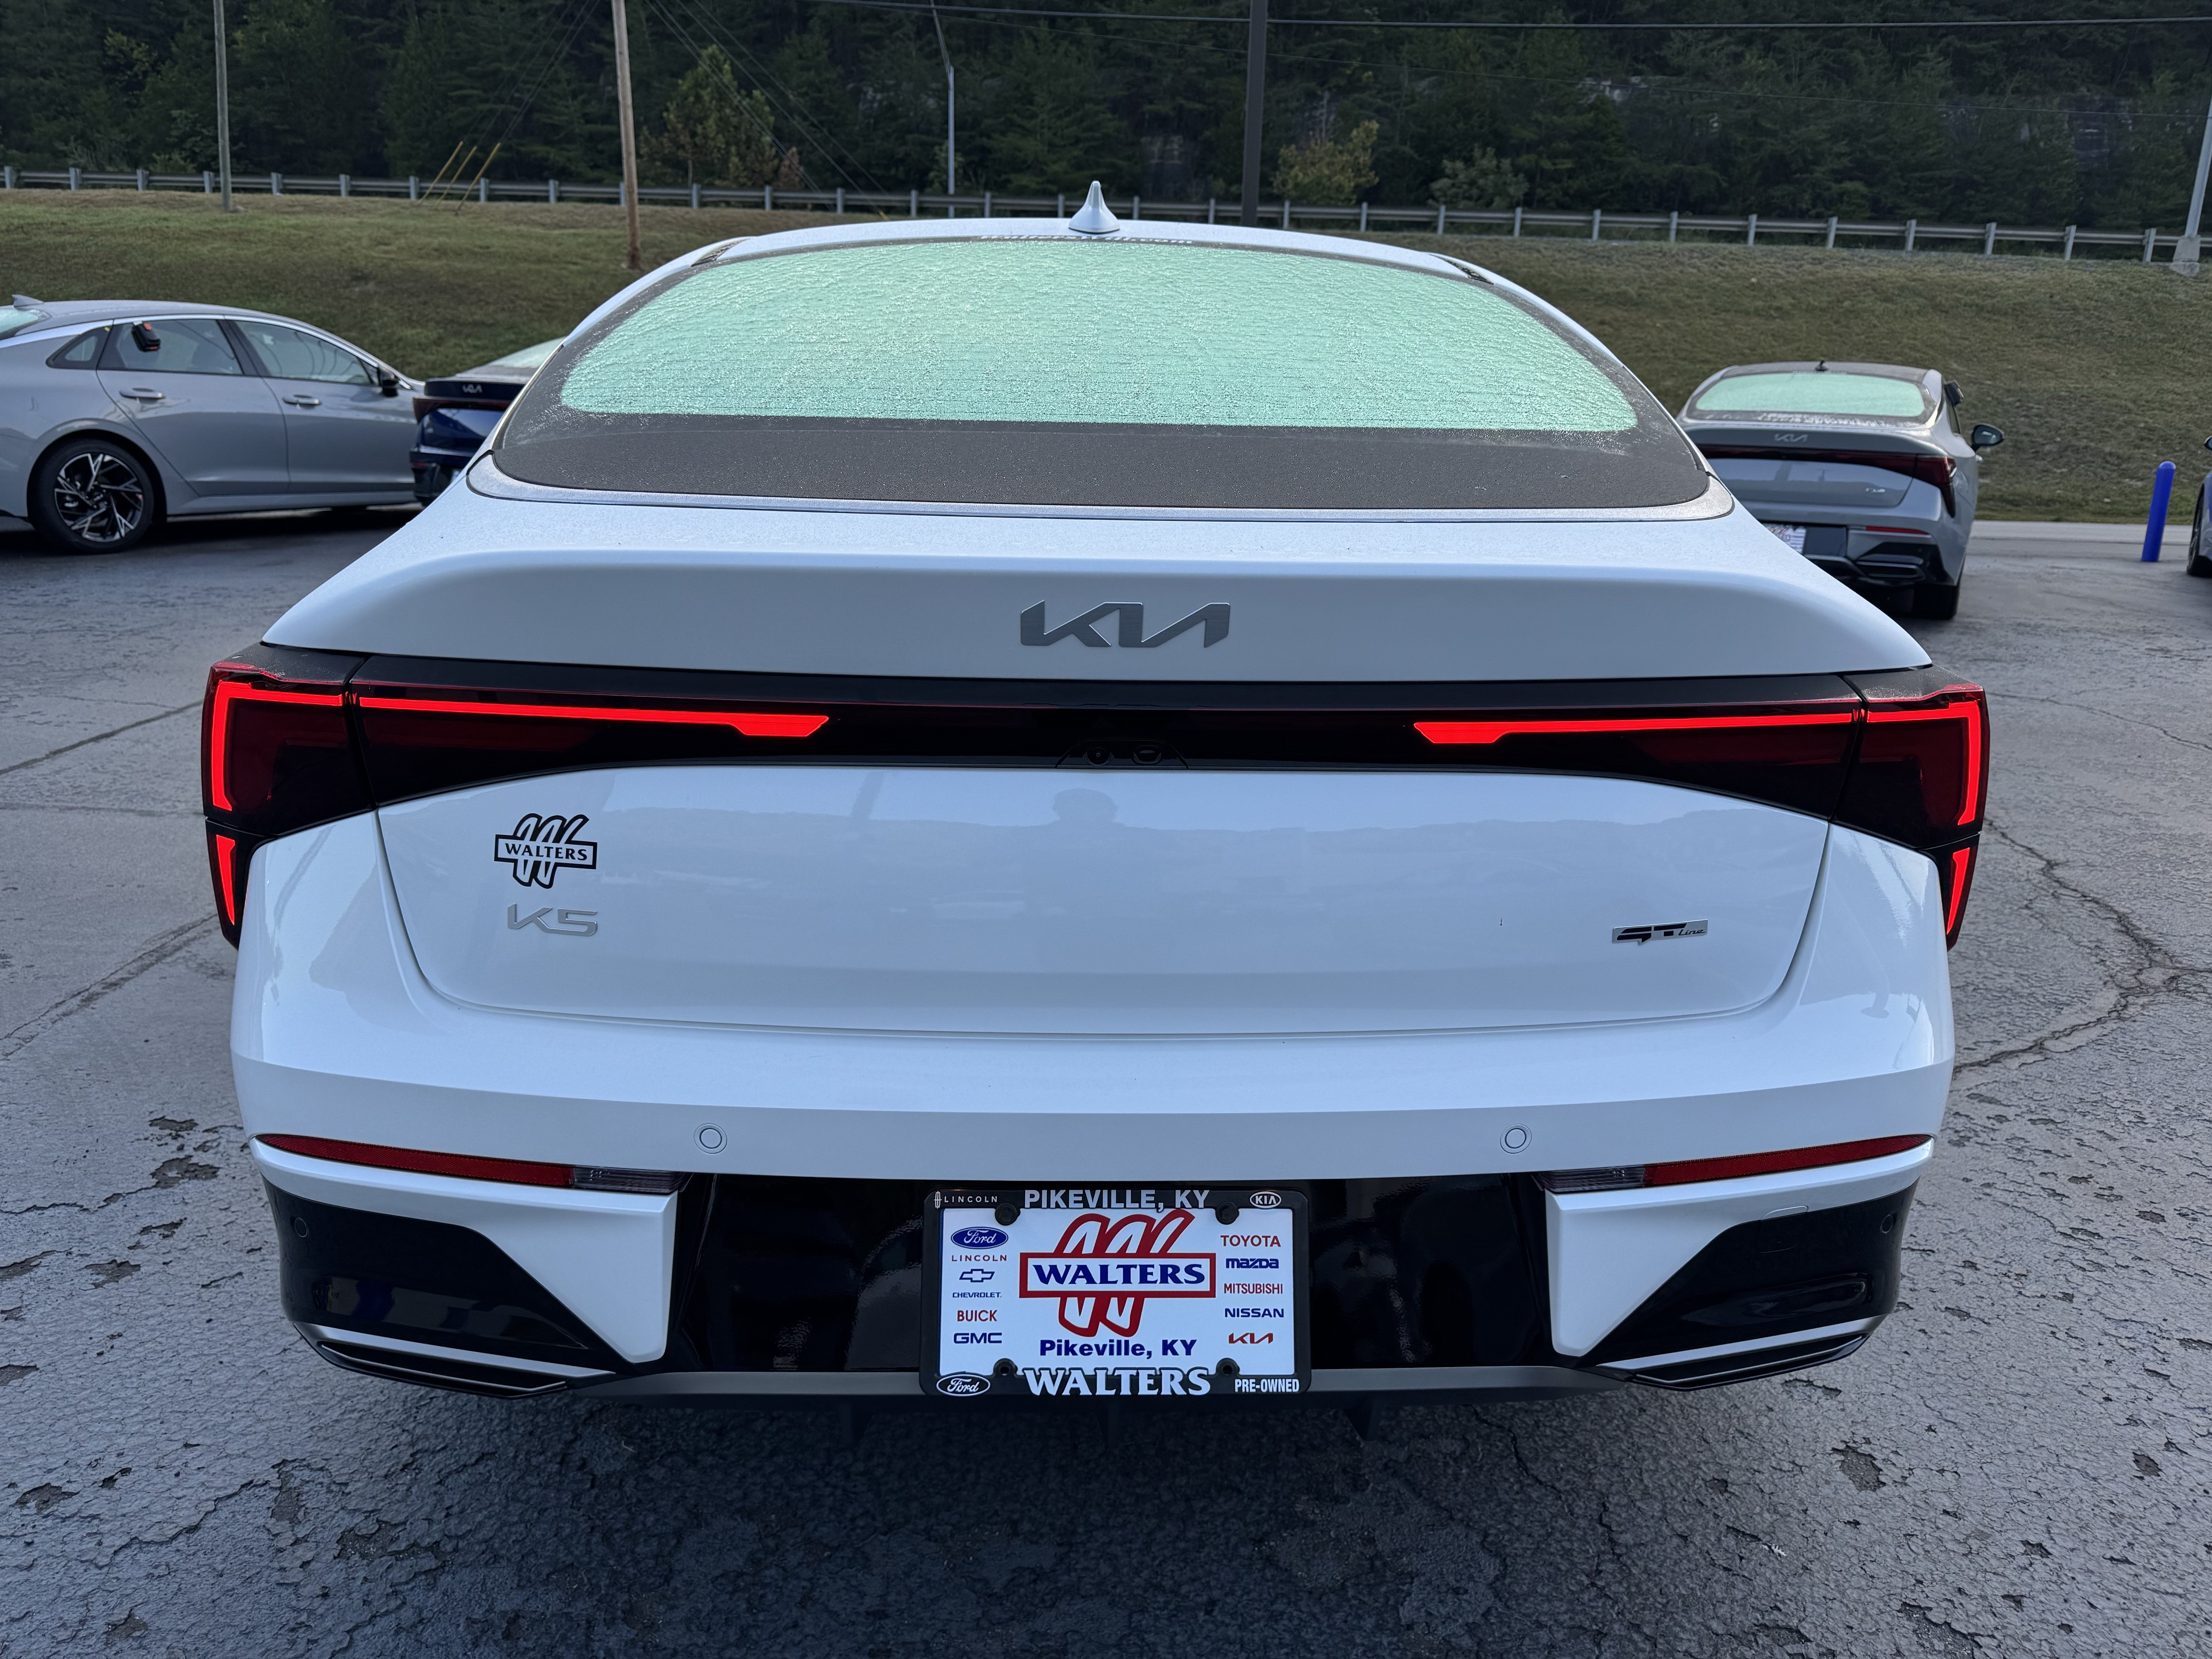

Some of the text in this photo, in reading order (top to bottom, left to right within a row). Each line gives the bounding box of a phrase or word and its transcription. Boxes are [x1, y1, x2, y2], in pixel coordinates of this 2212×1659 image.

[1020, 600, 1231, 647] KIA
[505, 843, 587, 860] WALTERS
[507, 903, 597, 936] K5
[1024, 1190, 1210, 1212] PIKEVILLE, KY
[1255, 1195, 1278, 1205] KIA
[963, 1230, 996, 1245] Ford
[1221, 1235, 1281, 1247] TOYOTA
[1032, 1264, 1205, 1284] WALTERS
[1224, 1283, 1283, 1295] MITSUBISHI
[957, 1310, 997, 1322] BUICK
[1224, 1308, 1284, 1318] NISSAN
[953, 1333, 1002, 1344] GMC
[1228, 1332, 1273, 1344] KIA
[1040, 1340, 1197, 1358] Pikeville, KY
[947, 1378, 981, 1393] Ford
[1024, 1368, 1211, 1396] WALTERS
[1235, 1379, 1299, 1393] PRE-OWNED
